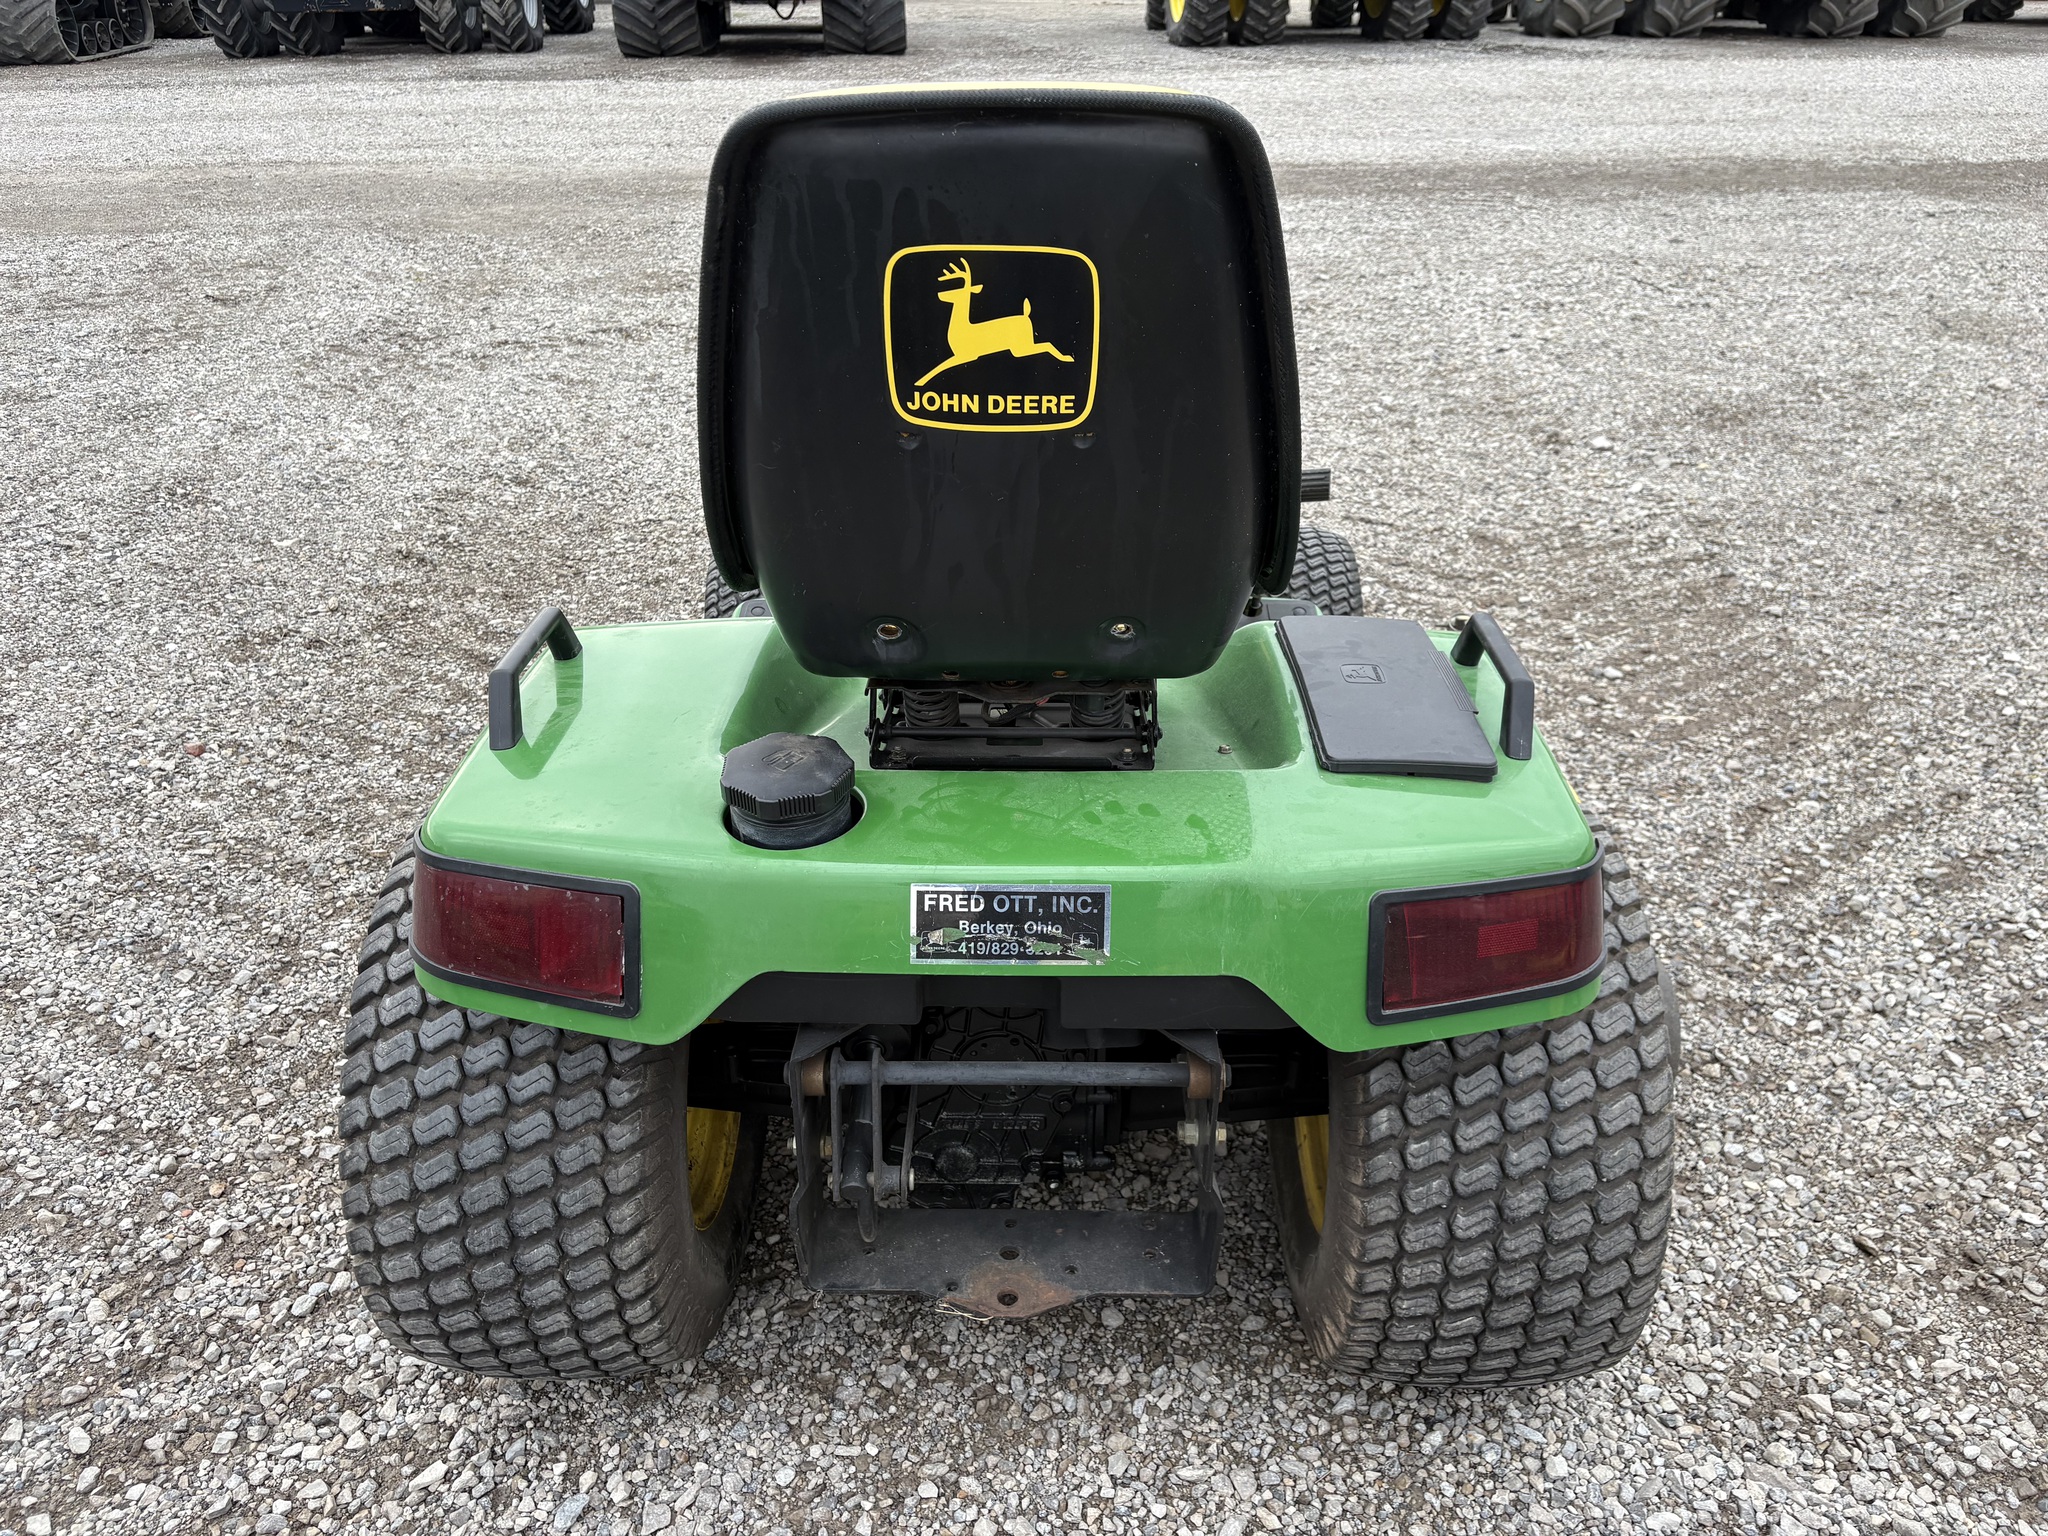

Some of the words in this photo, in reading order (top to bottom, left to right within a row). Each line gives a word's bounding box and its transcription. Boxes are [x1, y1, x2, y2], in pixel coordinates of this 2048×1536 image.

[906, 391, 980, 413] JOHN
[987, 394, 1075, 414] DEERE
[923, 893, 985, 912] FRED
[992, 894, 1044, 916] OTT,
[1052, 895, 1098, 914] INC.
[958, 920, 1019, 937] Berkey,
[1024, 920, 1063, 935] Ohio
